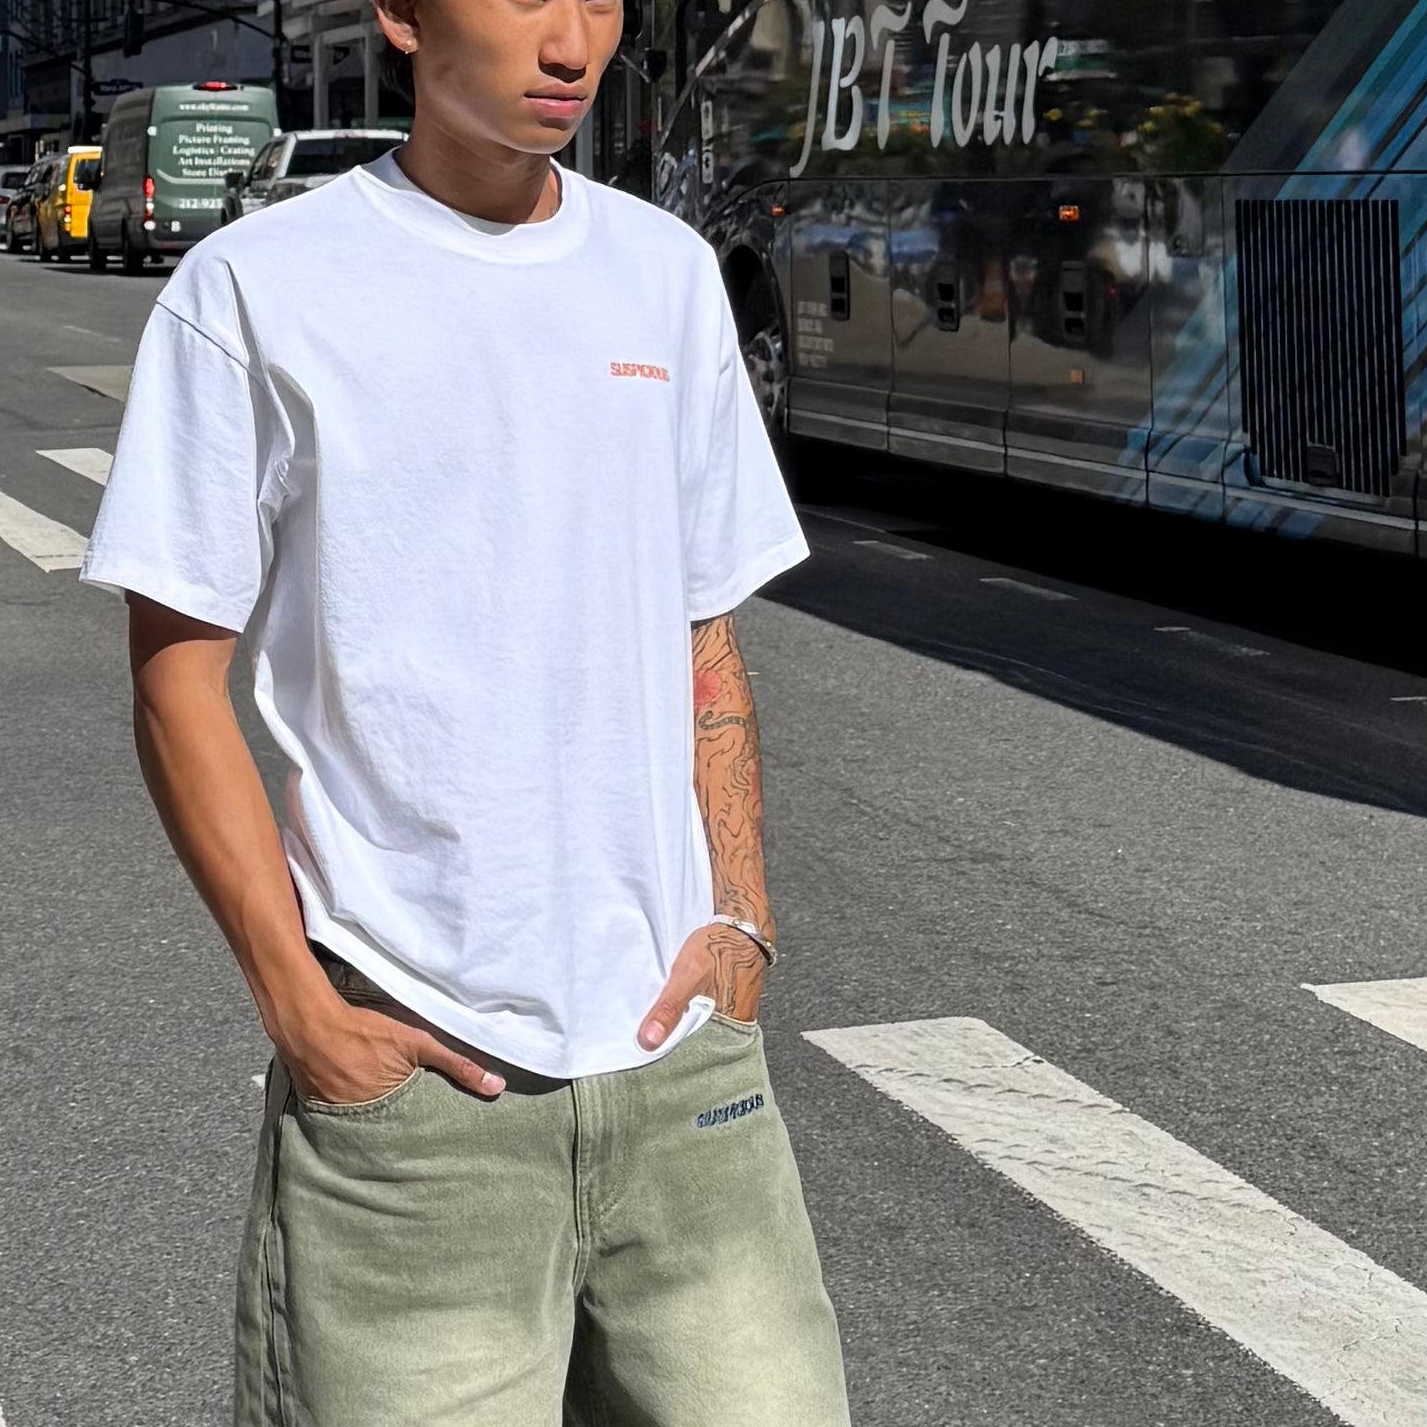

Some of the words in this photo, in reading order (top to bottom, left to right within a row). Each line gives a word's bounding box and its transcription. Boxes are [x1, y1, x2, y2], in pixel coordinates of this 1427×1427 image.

[789, 0, 913, 179] JBT
[196, 123, 233, 134] Printing
[178, 134, 212, 144] Picture
[213, 134, 250, 145] Framing
[172, 145, 215, 156] Logistics
[220, 145, 256, 157] Crating
[178, 157, 194, 166] Art
[195, 156, 251, 166] Installations
